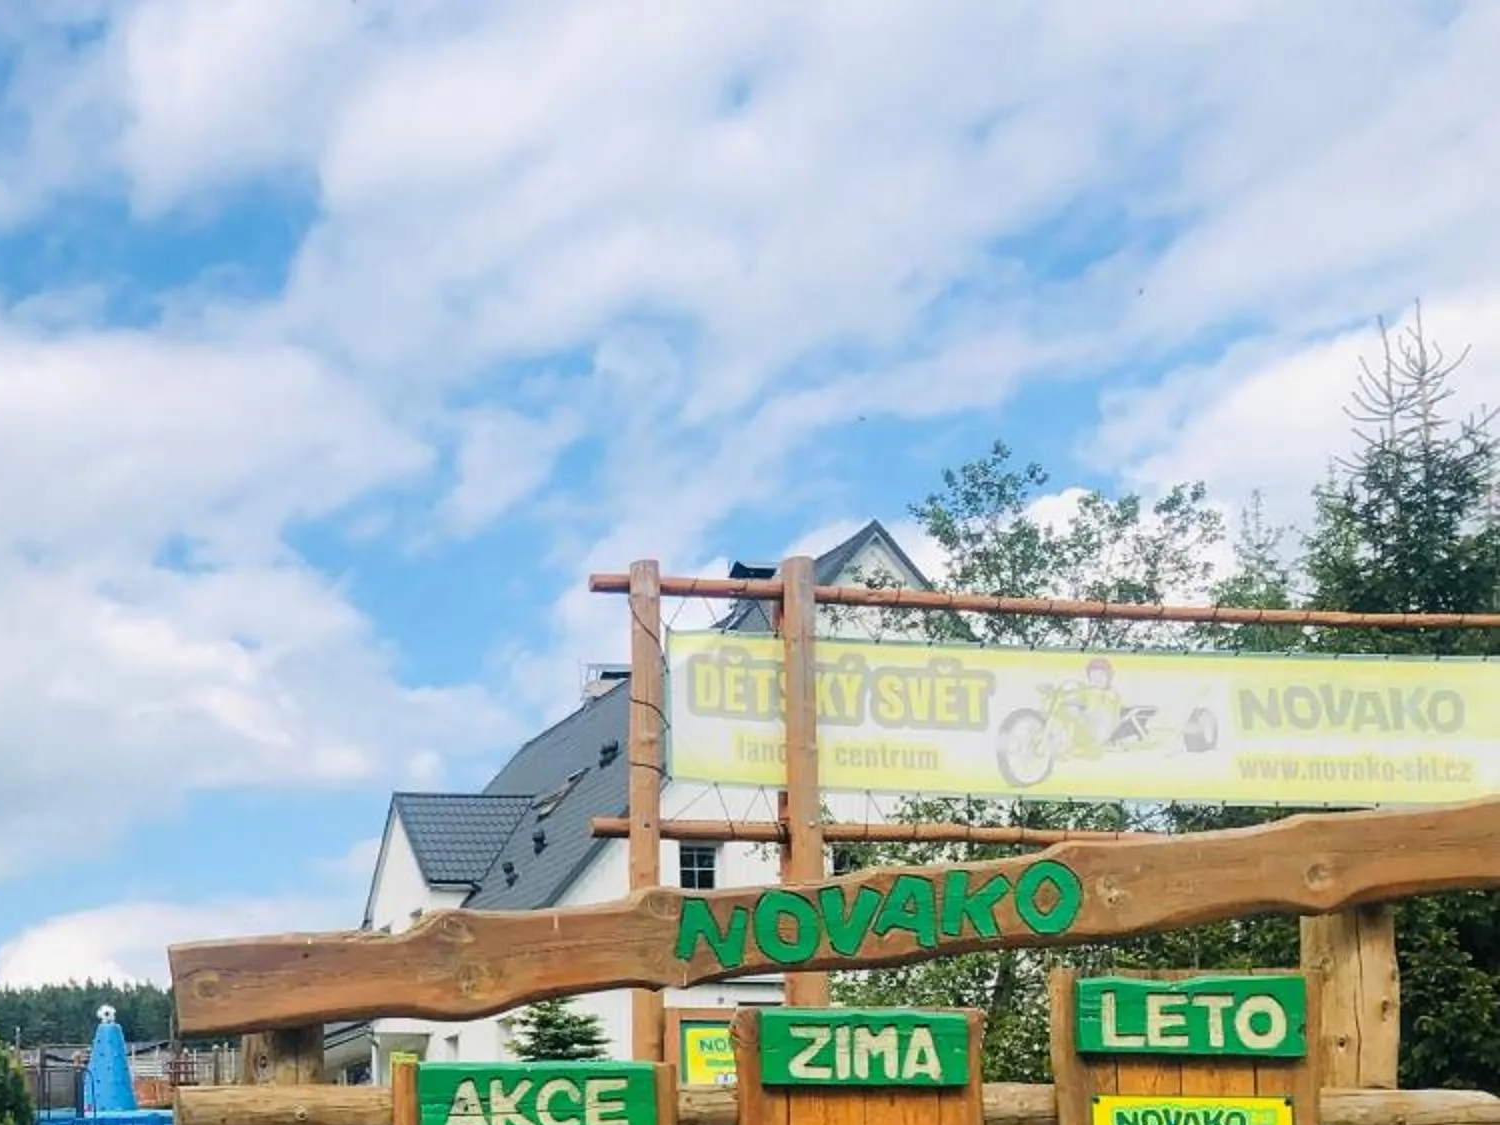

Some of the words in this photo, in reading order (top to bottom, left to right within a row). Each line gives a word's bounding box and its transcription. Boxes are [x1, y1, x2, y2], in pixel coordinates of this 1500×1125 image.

[876, 665, 989, 724] SVĚT
[1238, 683, 1466, 734] NOVAKO
[834, 742, 939, 770] centrum
[674, 859, 1084, 969] NOVAKO
[1100, 991, 1288, 1050] LETO
[787, 1024, 943, 1082] ZIMA
